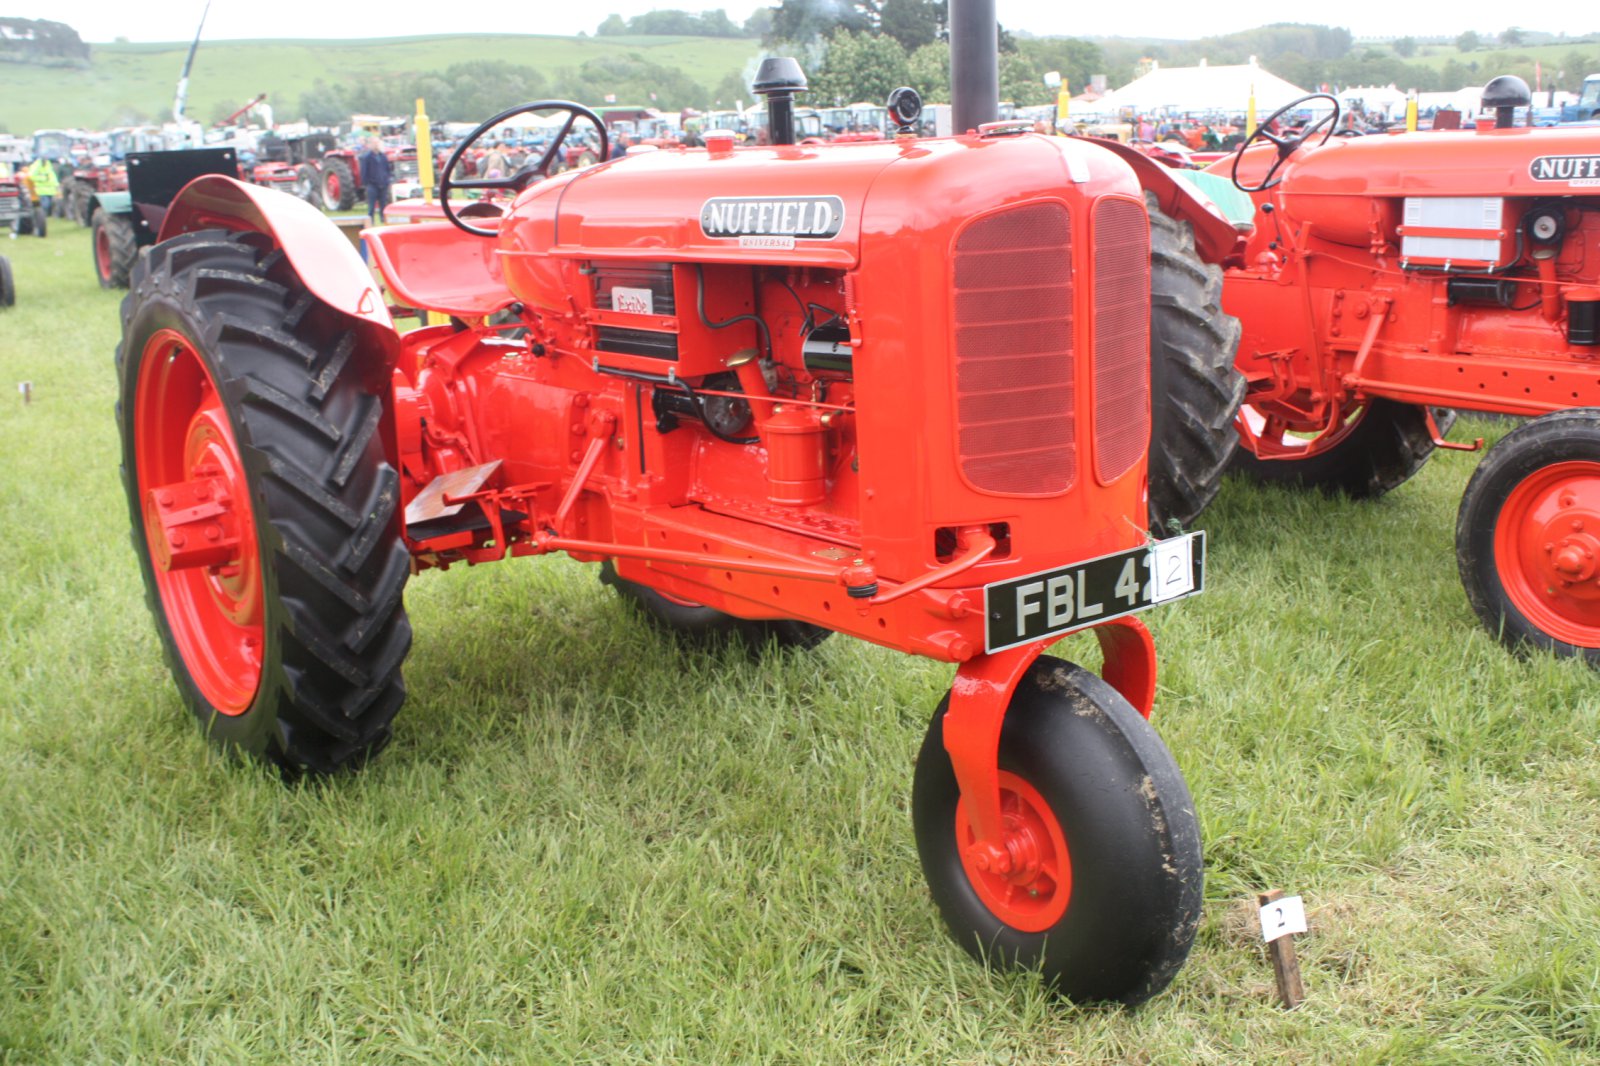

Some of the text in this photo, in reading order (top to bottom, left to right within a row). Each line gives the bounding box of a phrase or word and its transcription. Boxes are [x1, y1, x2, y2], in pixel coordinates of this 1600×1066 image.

[709, 201, 833, 234] NUFFIELD
[742, 238, 792, 247] UNIVERSAL
[617, 294, 647, 313] Exide
[1165, 555, 1182, 585] 2
[1016, 569, 1104, 637] FBL
[1275, 907, 1286, 928] 2
